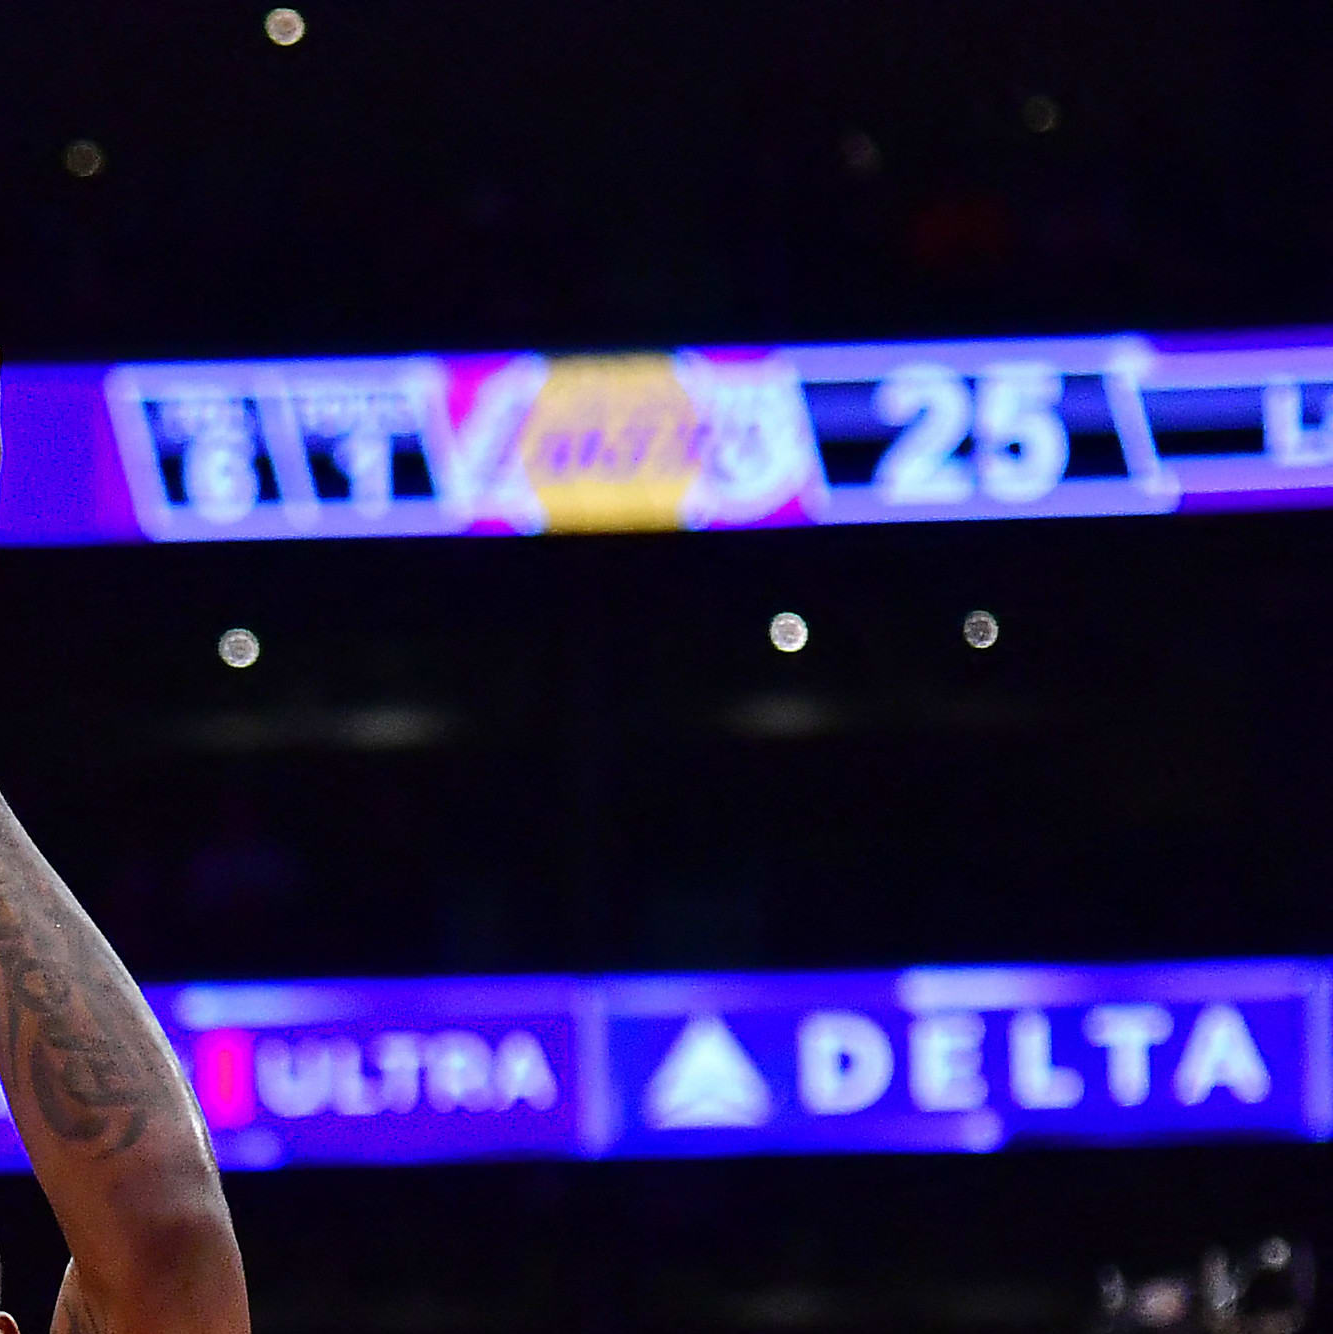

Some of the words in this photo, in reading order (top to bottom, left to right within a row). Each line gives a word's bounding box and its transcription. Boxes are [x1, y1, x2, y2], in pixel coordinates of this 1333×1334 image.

[872, 363, 1069, 504] 25
[255, 1030, 558, 1118] ULTRA
[797, 1002, 1271, 1115] DELTA
